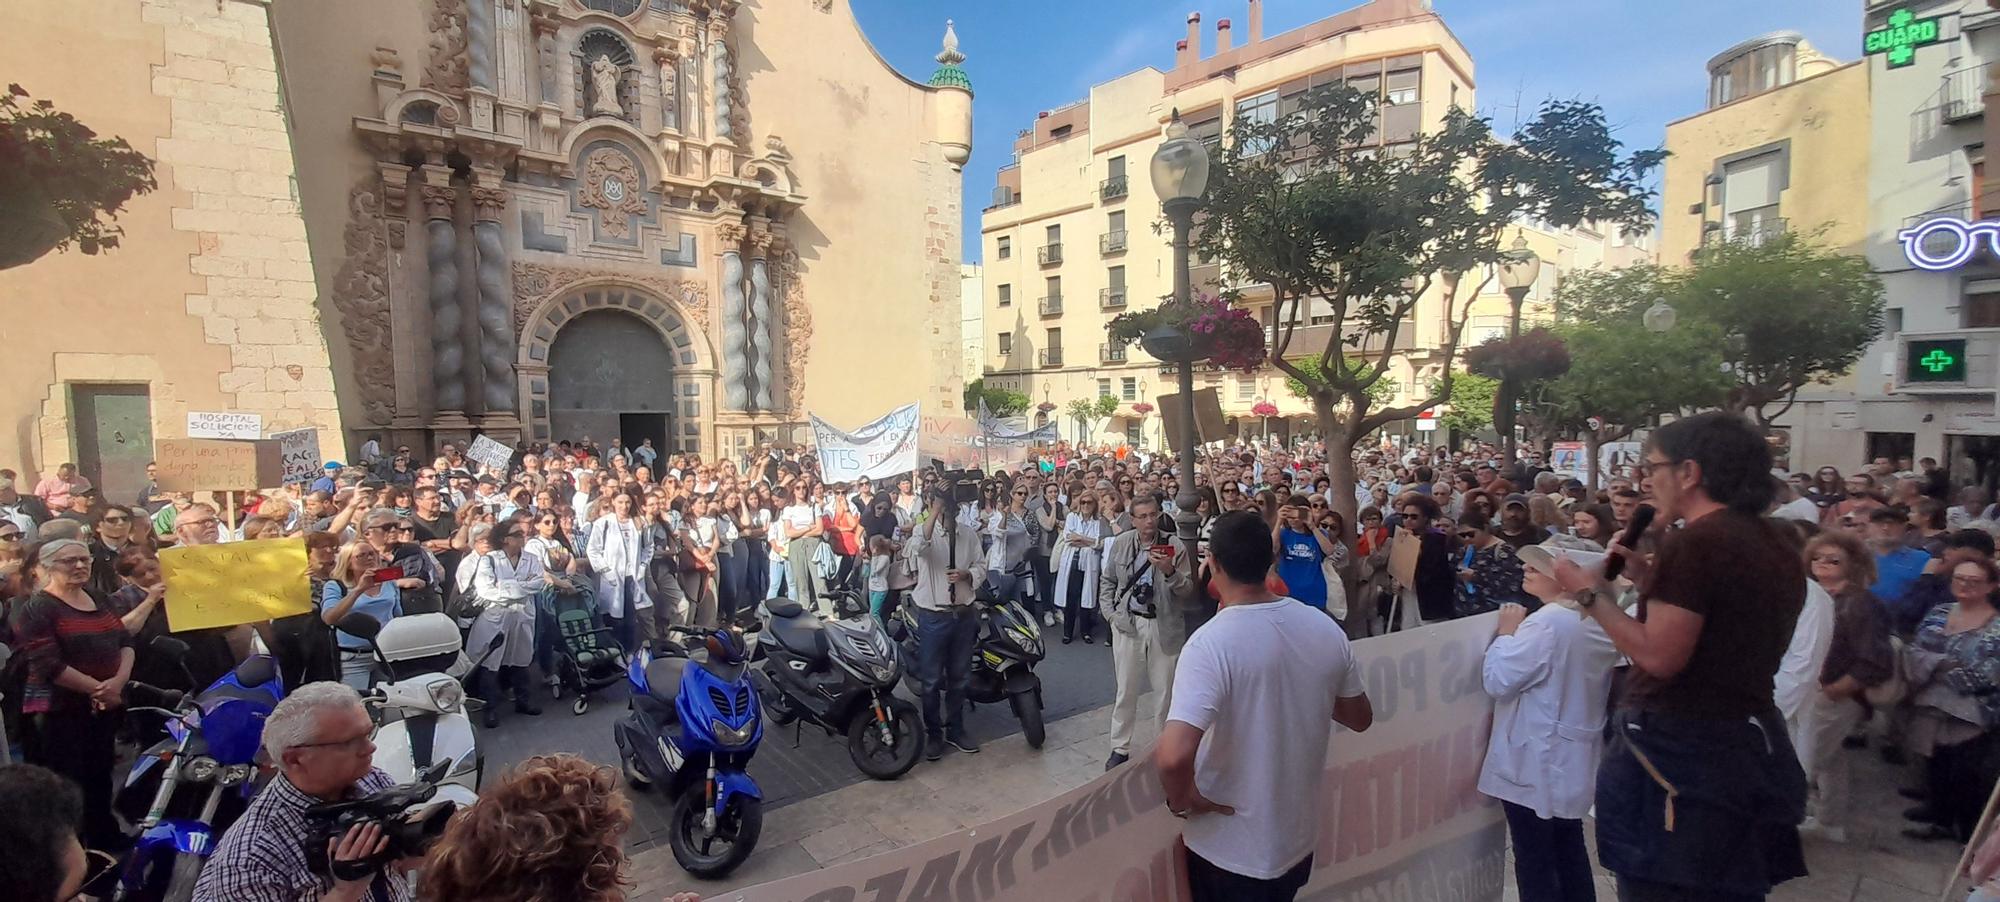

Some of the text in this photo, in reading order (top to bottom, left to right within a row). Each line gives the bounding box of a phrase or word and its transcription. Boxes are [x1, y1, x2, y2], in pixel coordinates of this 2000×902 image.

[1866, 21, 1937, 51] GUARD
[199, 413, 255, 424] HOSPITAL
[190, 421, 259, 432] SOLUCIONS
[819, 431, 837, 443] PER
